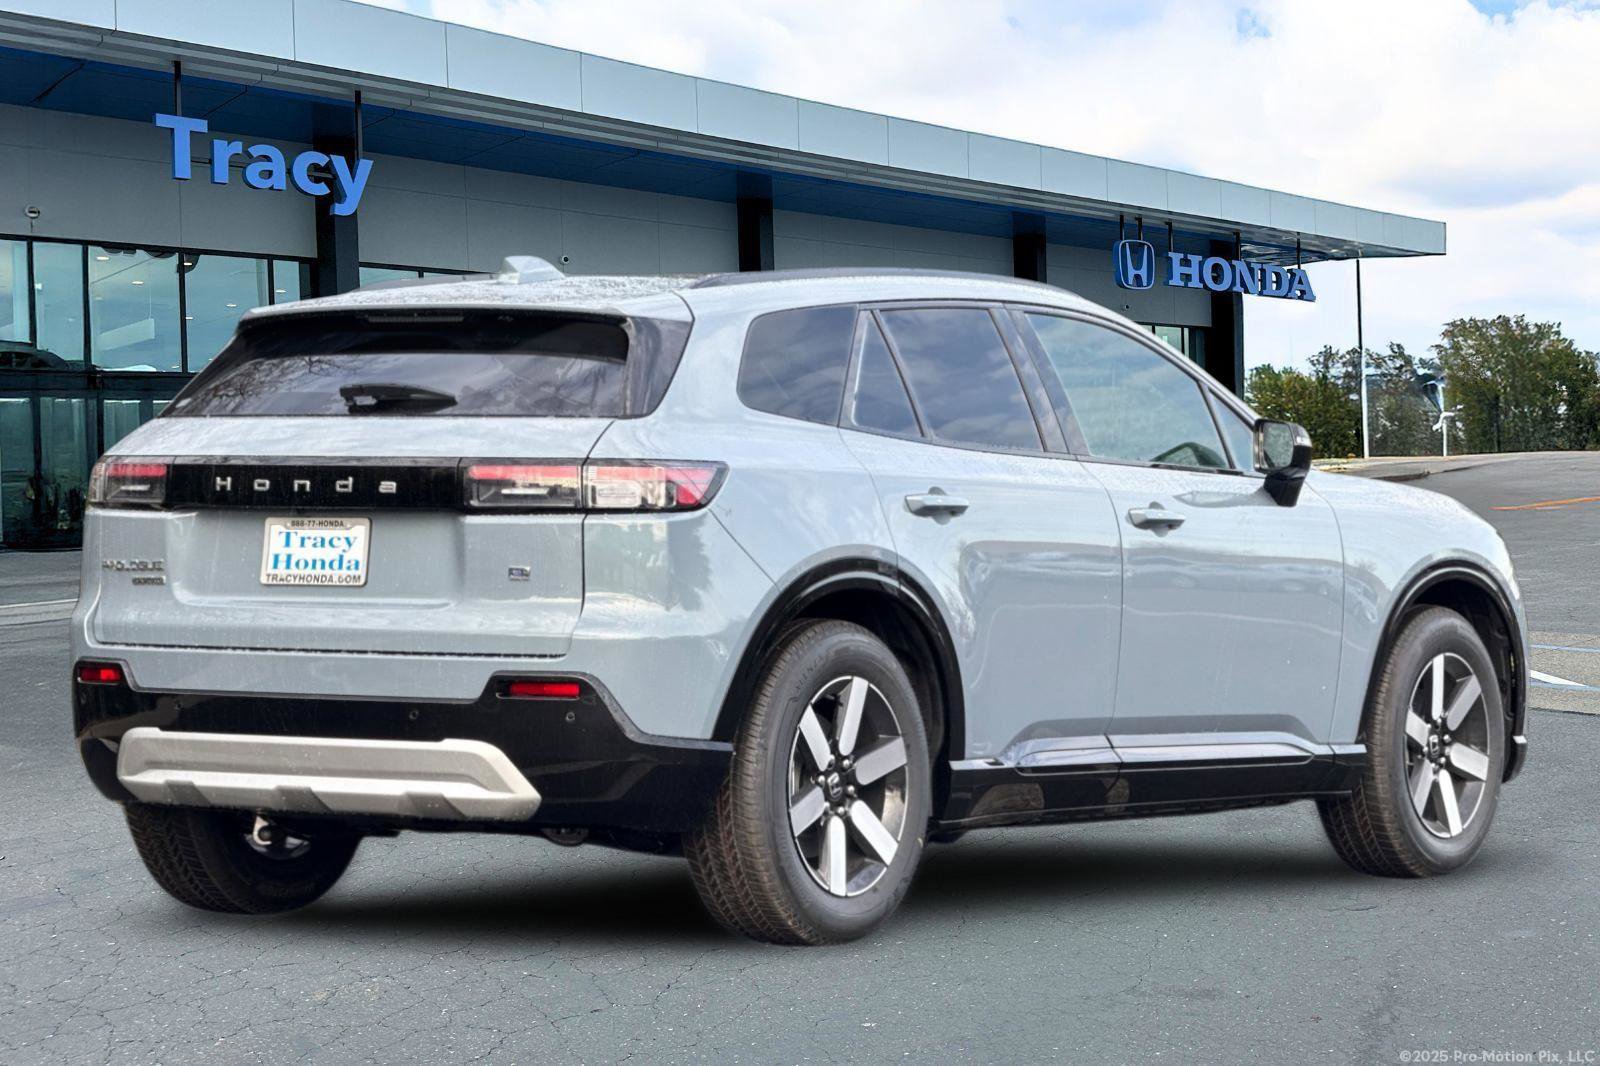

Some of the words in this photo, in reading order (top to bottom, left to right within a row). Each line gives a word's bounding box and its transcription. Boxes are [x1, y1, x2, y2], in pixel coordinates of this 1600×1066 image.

[155, 113, 374, 216] Tracy
[1165, 252, 1317, 301] HONDA
[215, 476, 397, 493] Honda
[291, 519, 344, 527] 888-77-HONDA
[278, 531, 357, 553] Tracy
[272, 553, 360, 571] Honda
